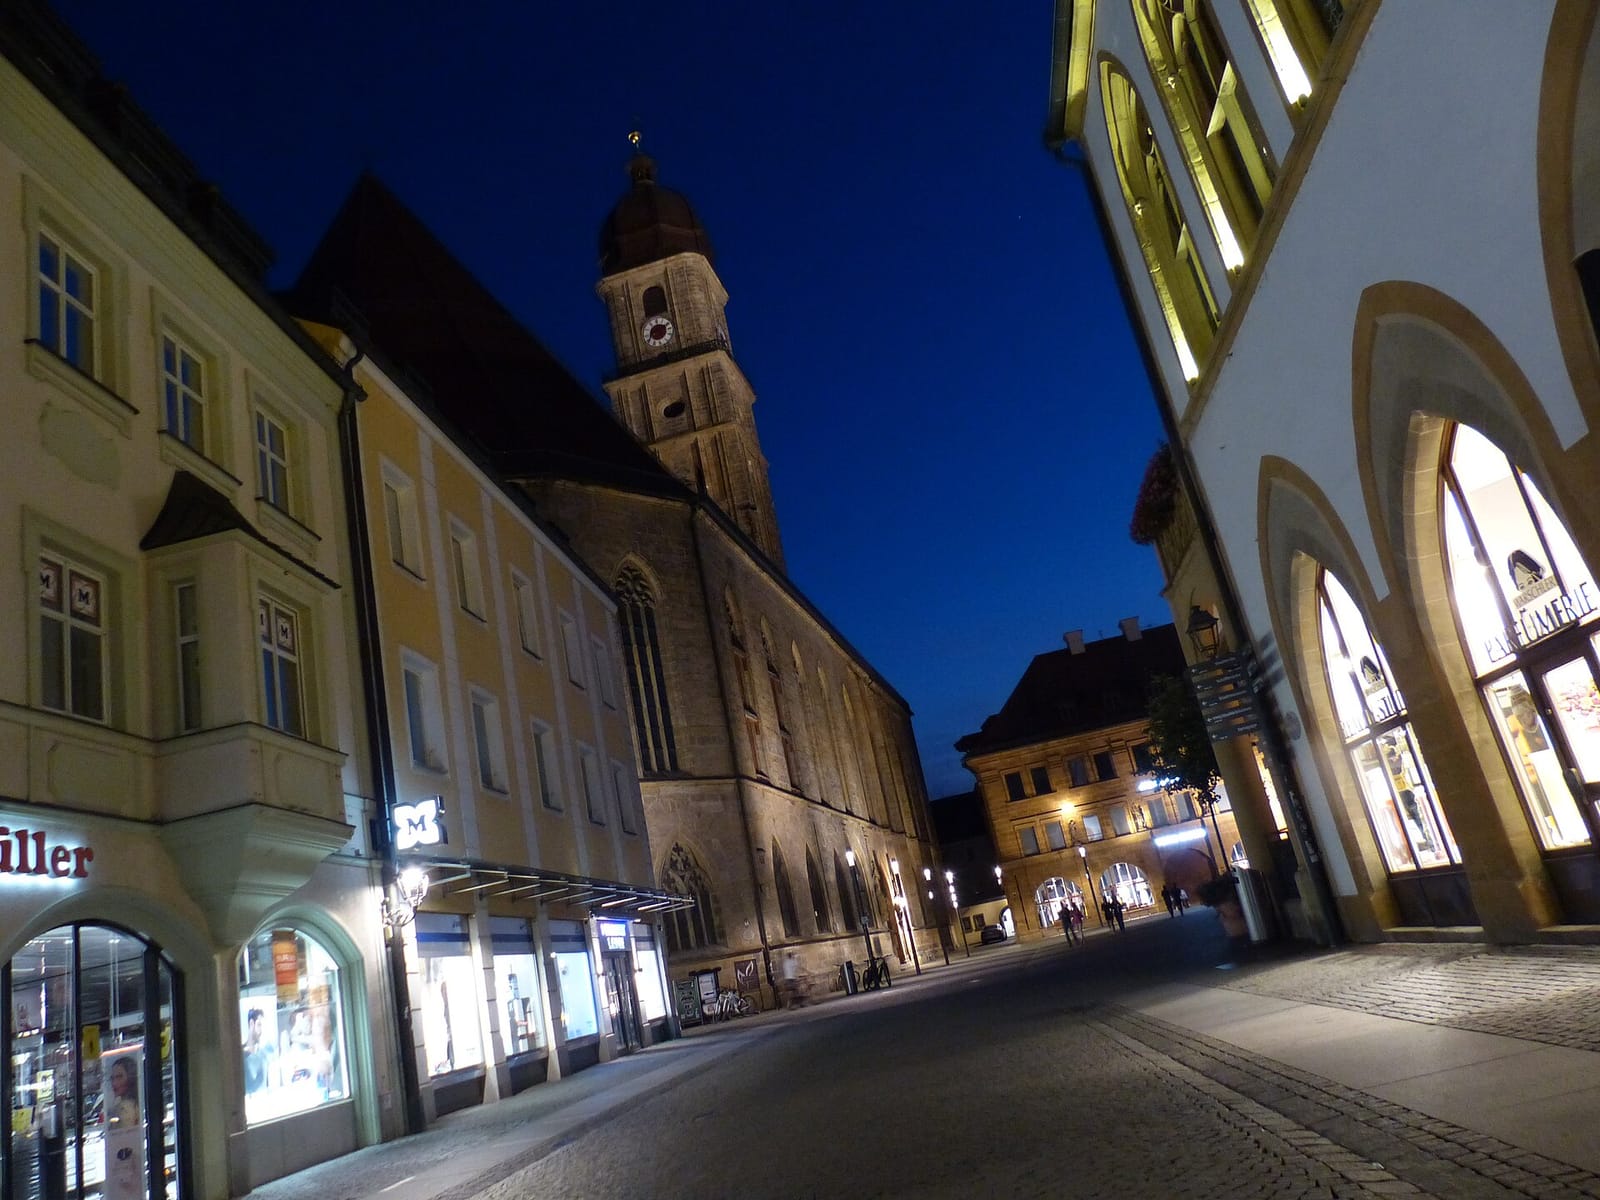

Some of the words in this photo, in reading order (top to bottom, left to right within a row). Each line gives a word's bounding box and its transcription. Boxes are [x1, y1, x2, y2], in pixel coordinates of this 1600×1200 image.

[78, 588, 90, 605] M
[1484, 582, 1598, 663] PARFÜMERIE
[406, 814, 427, 835] M
